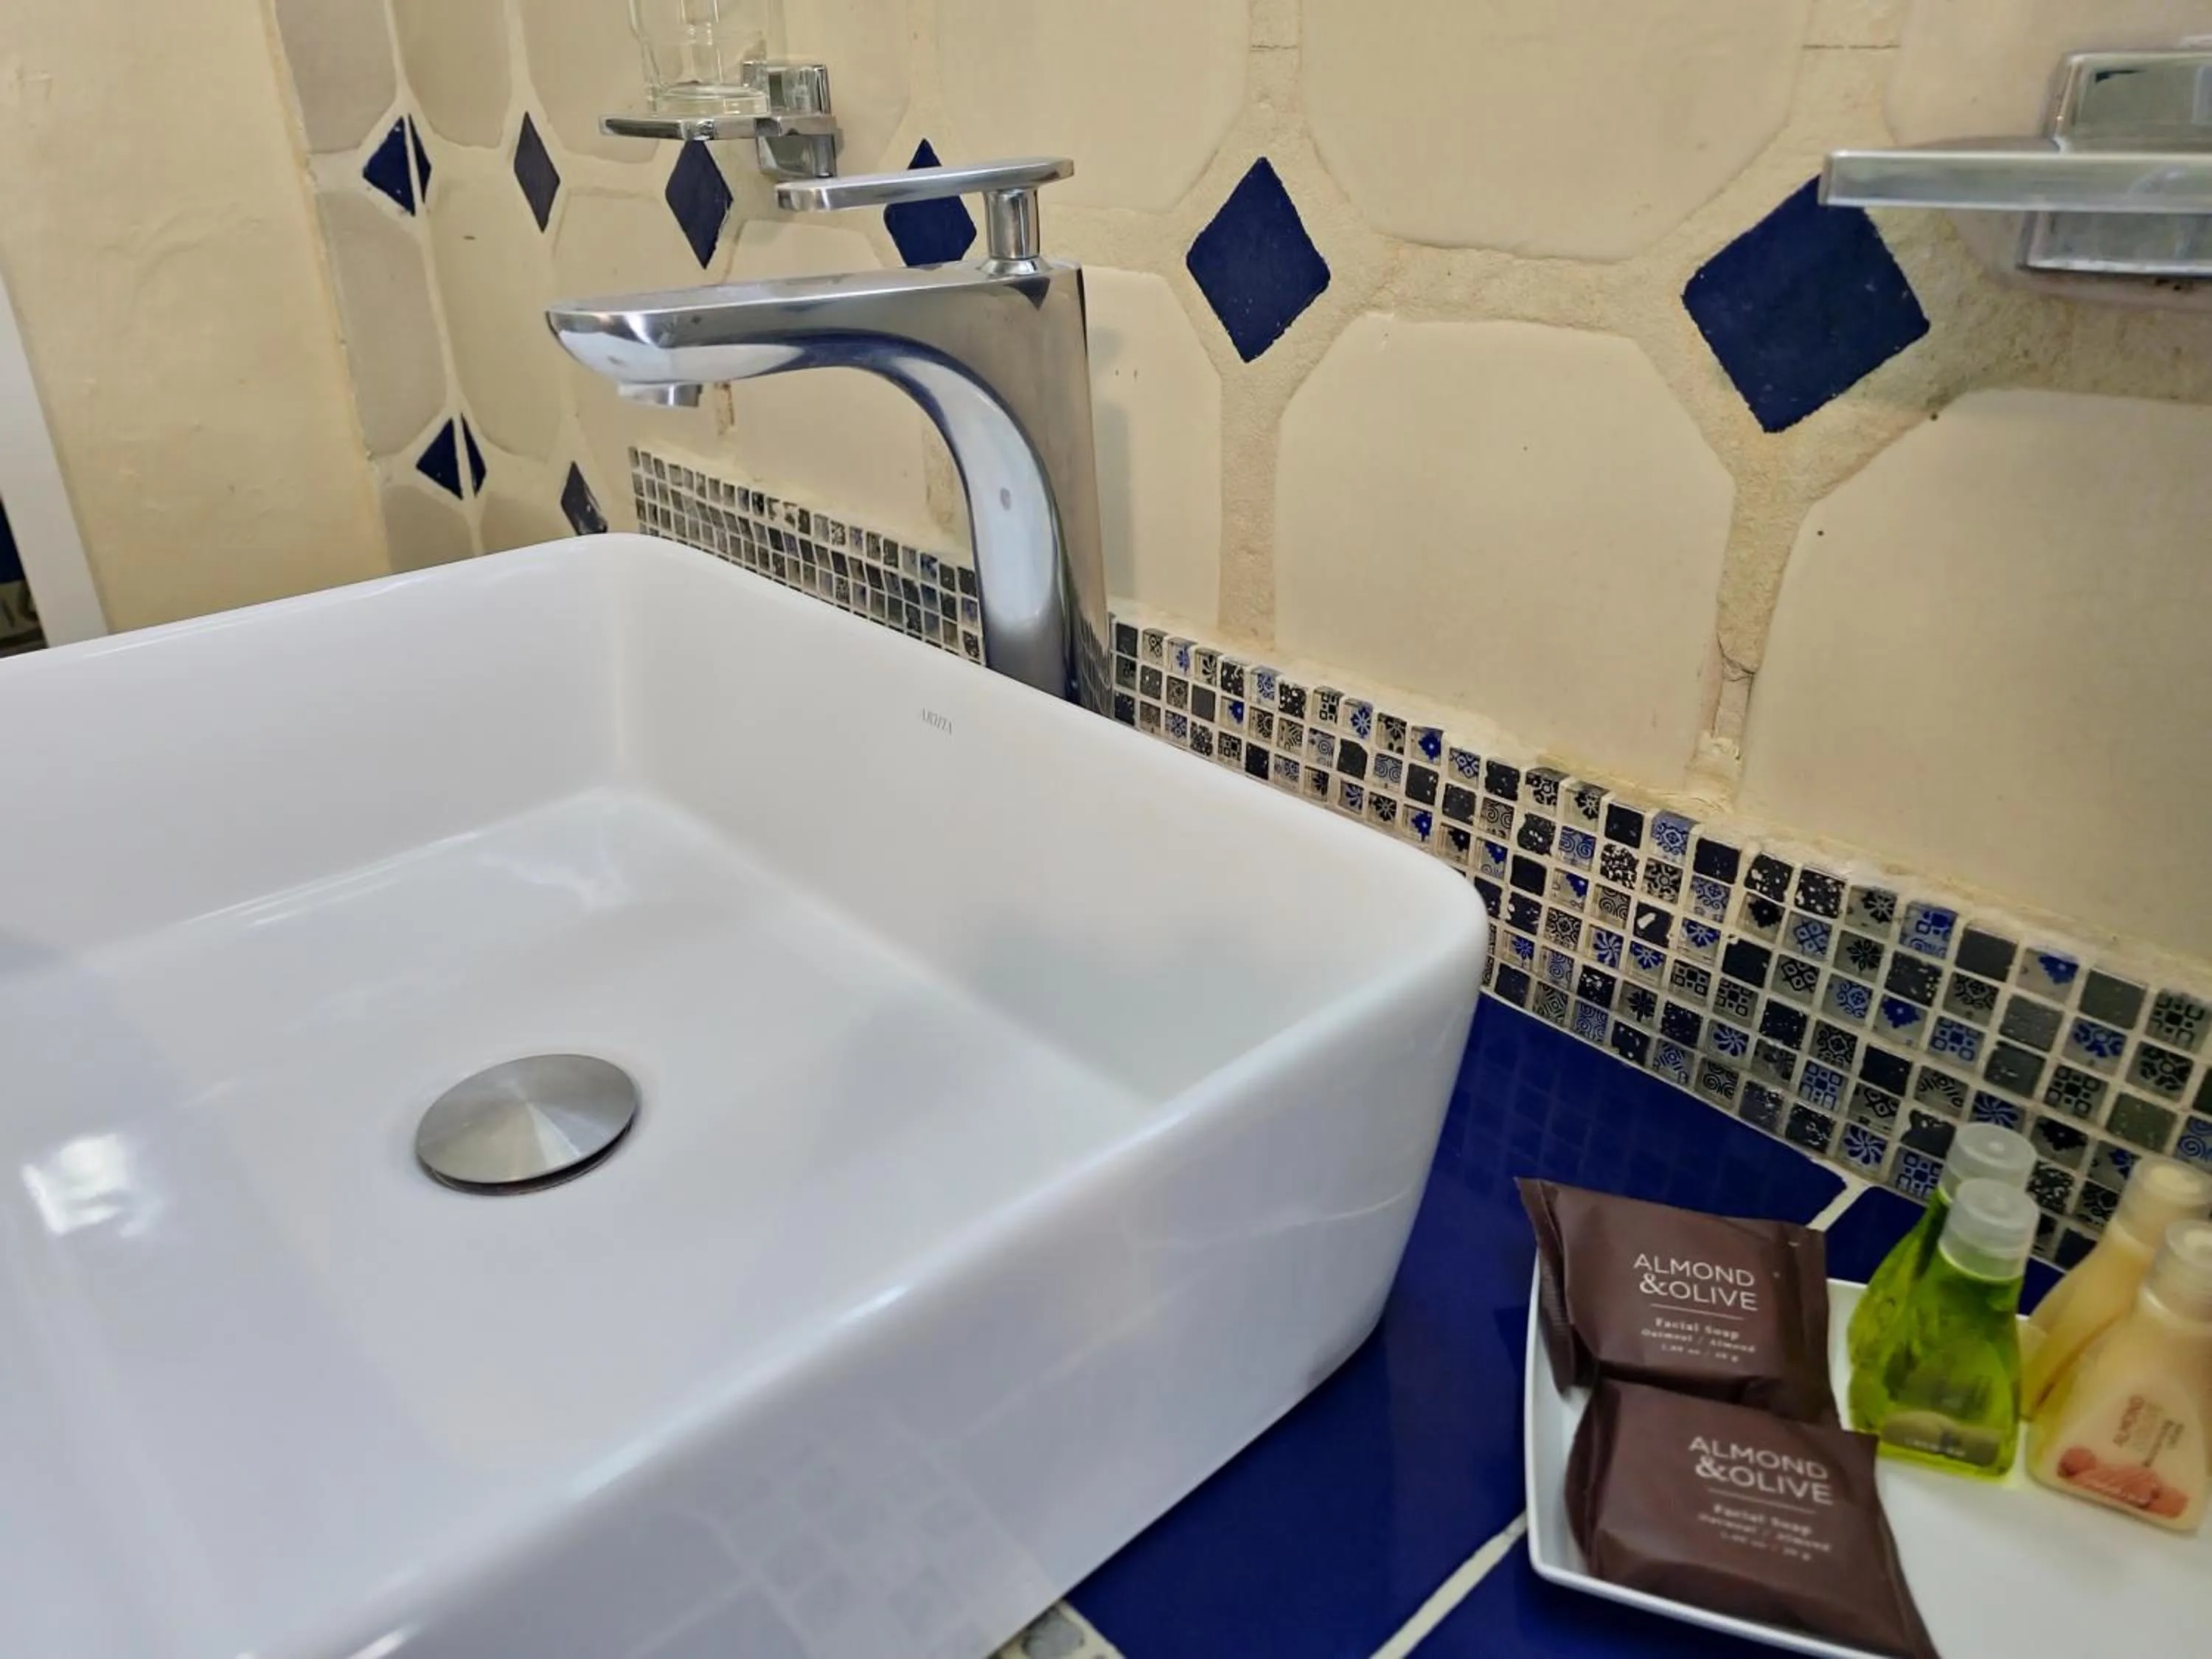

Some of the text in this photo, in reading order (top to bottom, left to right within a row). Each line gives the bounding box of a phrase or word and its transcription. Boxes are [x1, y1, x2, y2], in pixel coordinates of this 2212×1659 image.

[1634, 1253, 1755, 1287] ALMOND
[1640, 1273, 1758, 1311] &OLIVE
[1655, 1317, 1739, 1341] Facial Soap
[1688, 1436, 1829, 1480] ALMOND
[1694, 1455, 1833, 1505] &OLIVE
